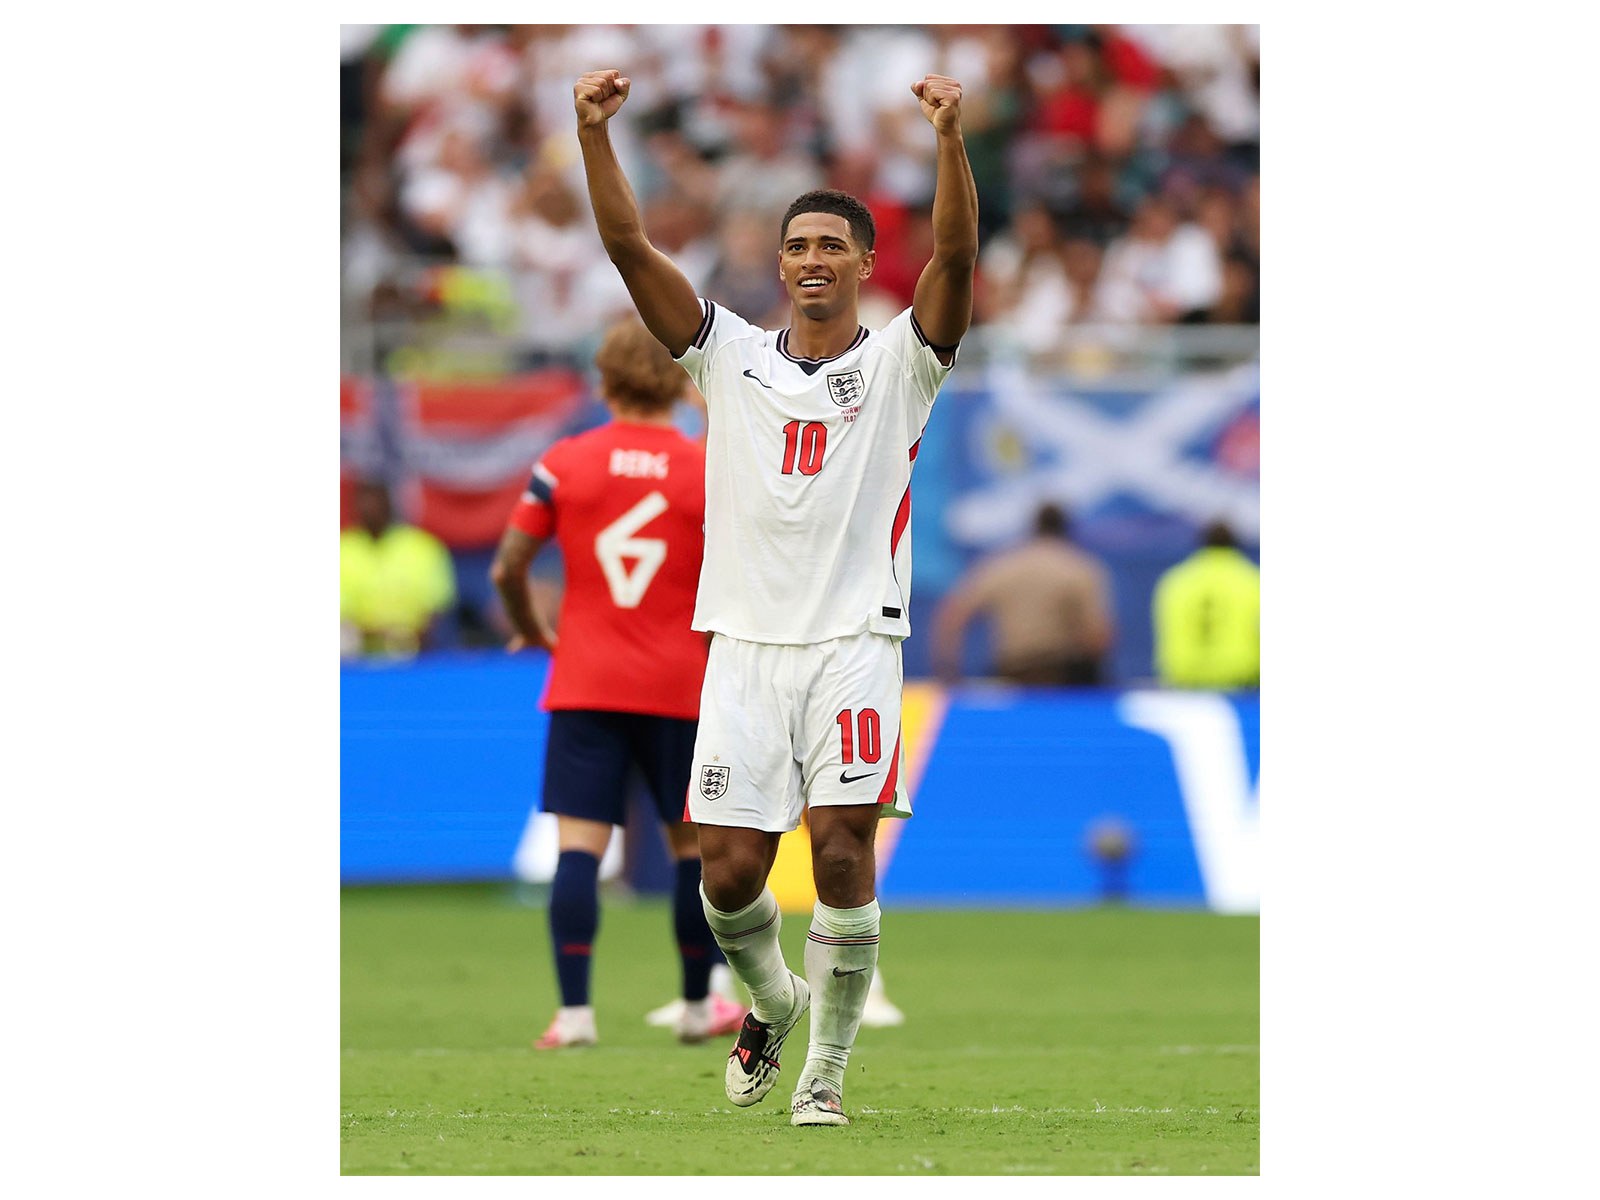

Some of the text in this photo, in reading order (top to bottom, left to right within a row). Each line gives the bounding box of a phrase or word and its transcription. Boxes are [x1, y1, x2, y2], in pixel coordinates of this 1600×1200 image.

[609, 449, 669, 479] BERG
[782, 421, 828, 476] 10
[595, 491, 669, 608] 6
[836, 708, 881, 764] 10
